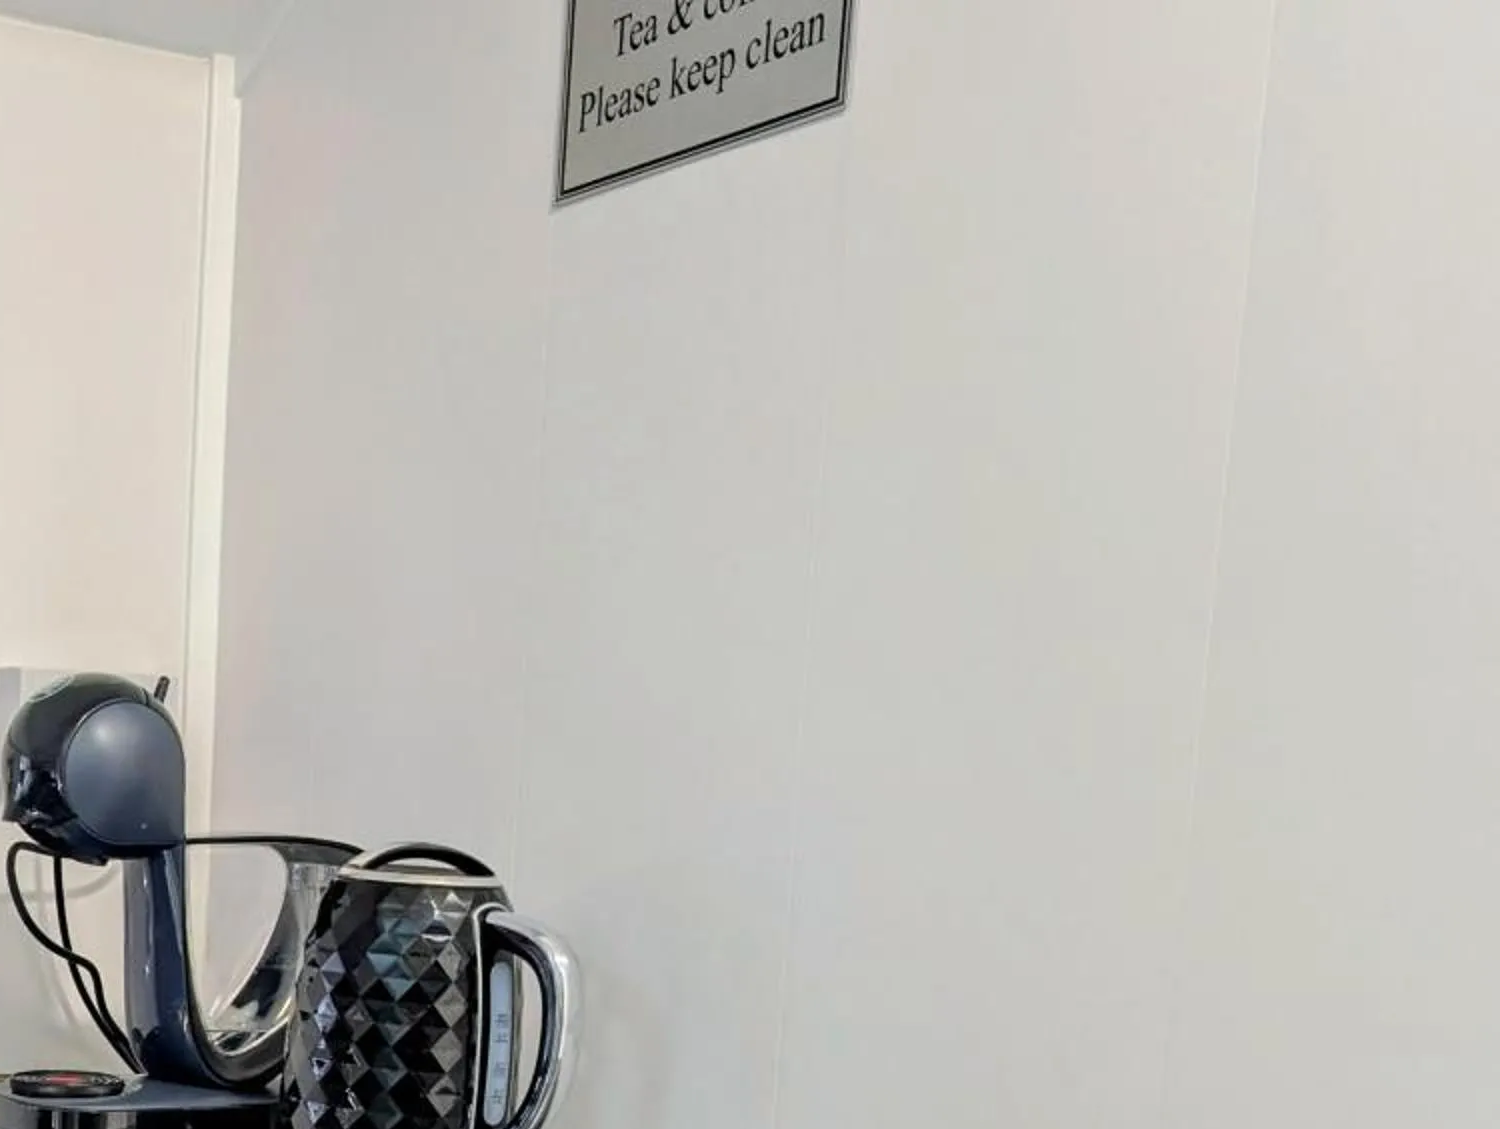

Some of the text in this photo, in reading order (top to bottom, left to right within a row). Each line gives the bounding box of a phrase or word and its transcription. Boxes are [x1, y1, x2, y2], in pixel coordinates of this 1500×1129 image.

[578, 12, 825, 132] Please keep clean
[613, 13, 657, 57] Tea
[667, 0, 693, 35] &
